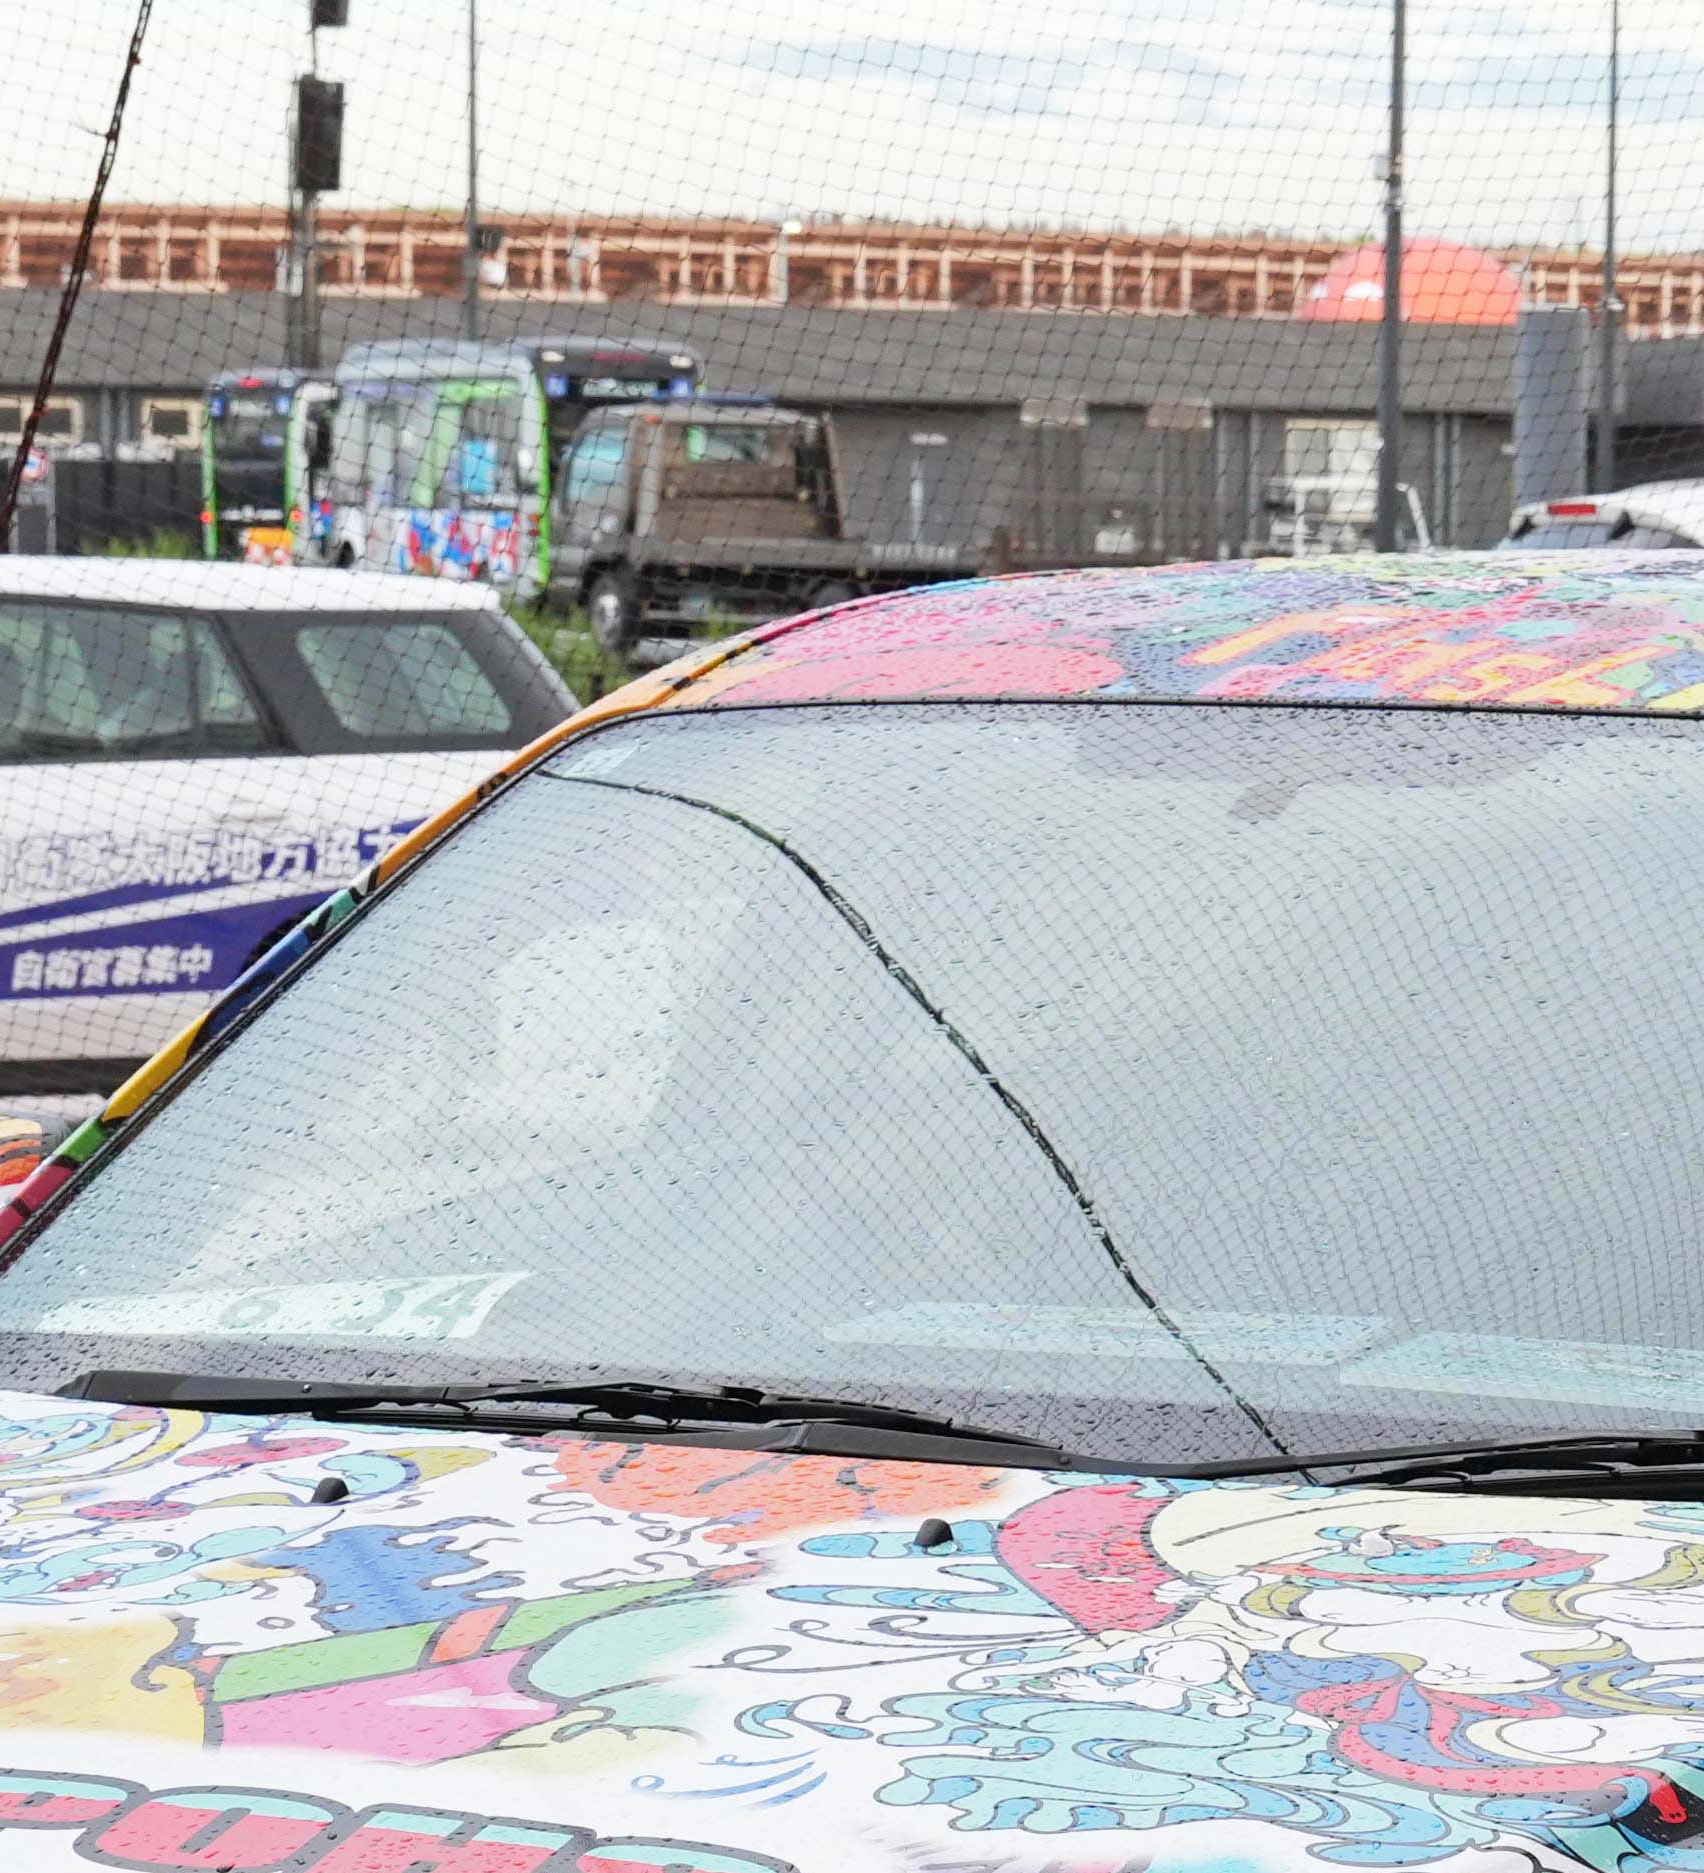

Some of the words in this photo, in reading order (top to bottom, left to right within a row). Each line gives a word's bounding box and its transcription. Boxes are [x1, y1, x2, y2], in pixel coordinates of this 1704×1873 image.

[11, 943, 214, 992] 自衛官募集中
